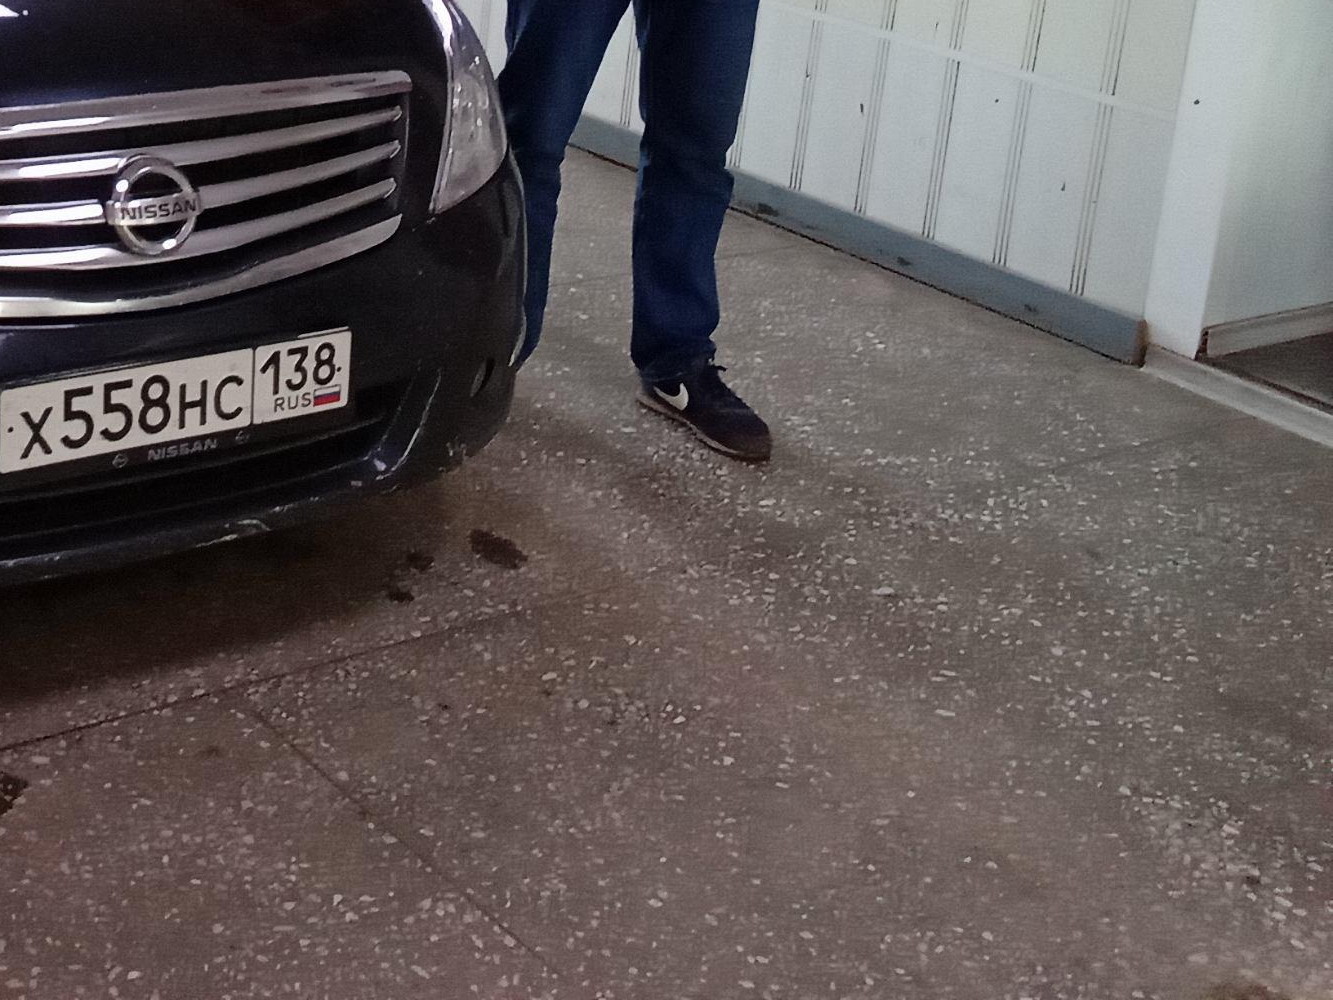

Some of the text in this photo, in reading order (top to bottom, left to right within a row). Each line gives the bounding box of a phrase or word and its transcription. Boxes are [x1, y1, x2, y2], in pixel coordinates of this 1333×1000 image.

[121, 199, 197, 220] NISSAN
[260, 342, 336, 395] 138
[273, 391, 313, 413] RUS
[147, 437, 219, 462] NISSAN
